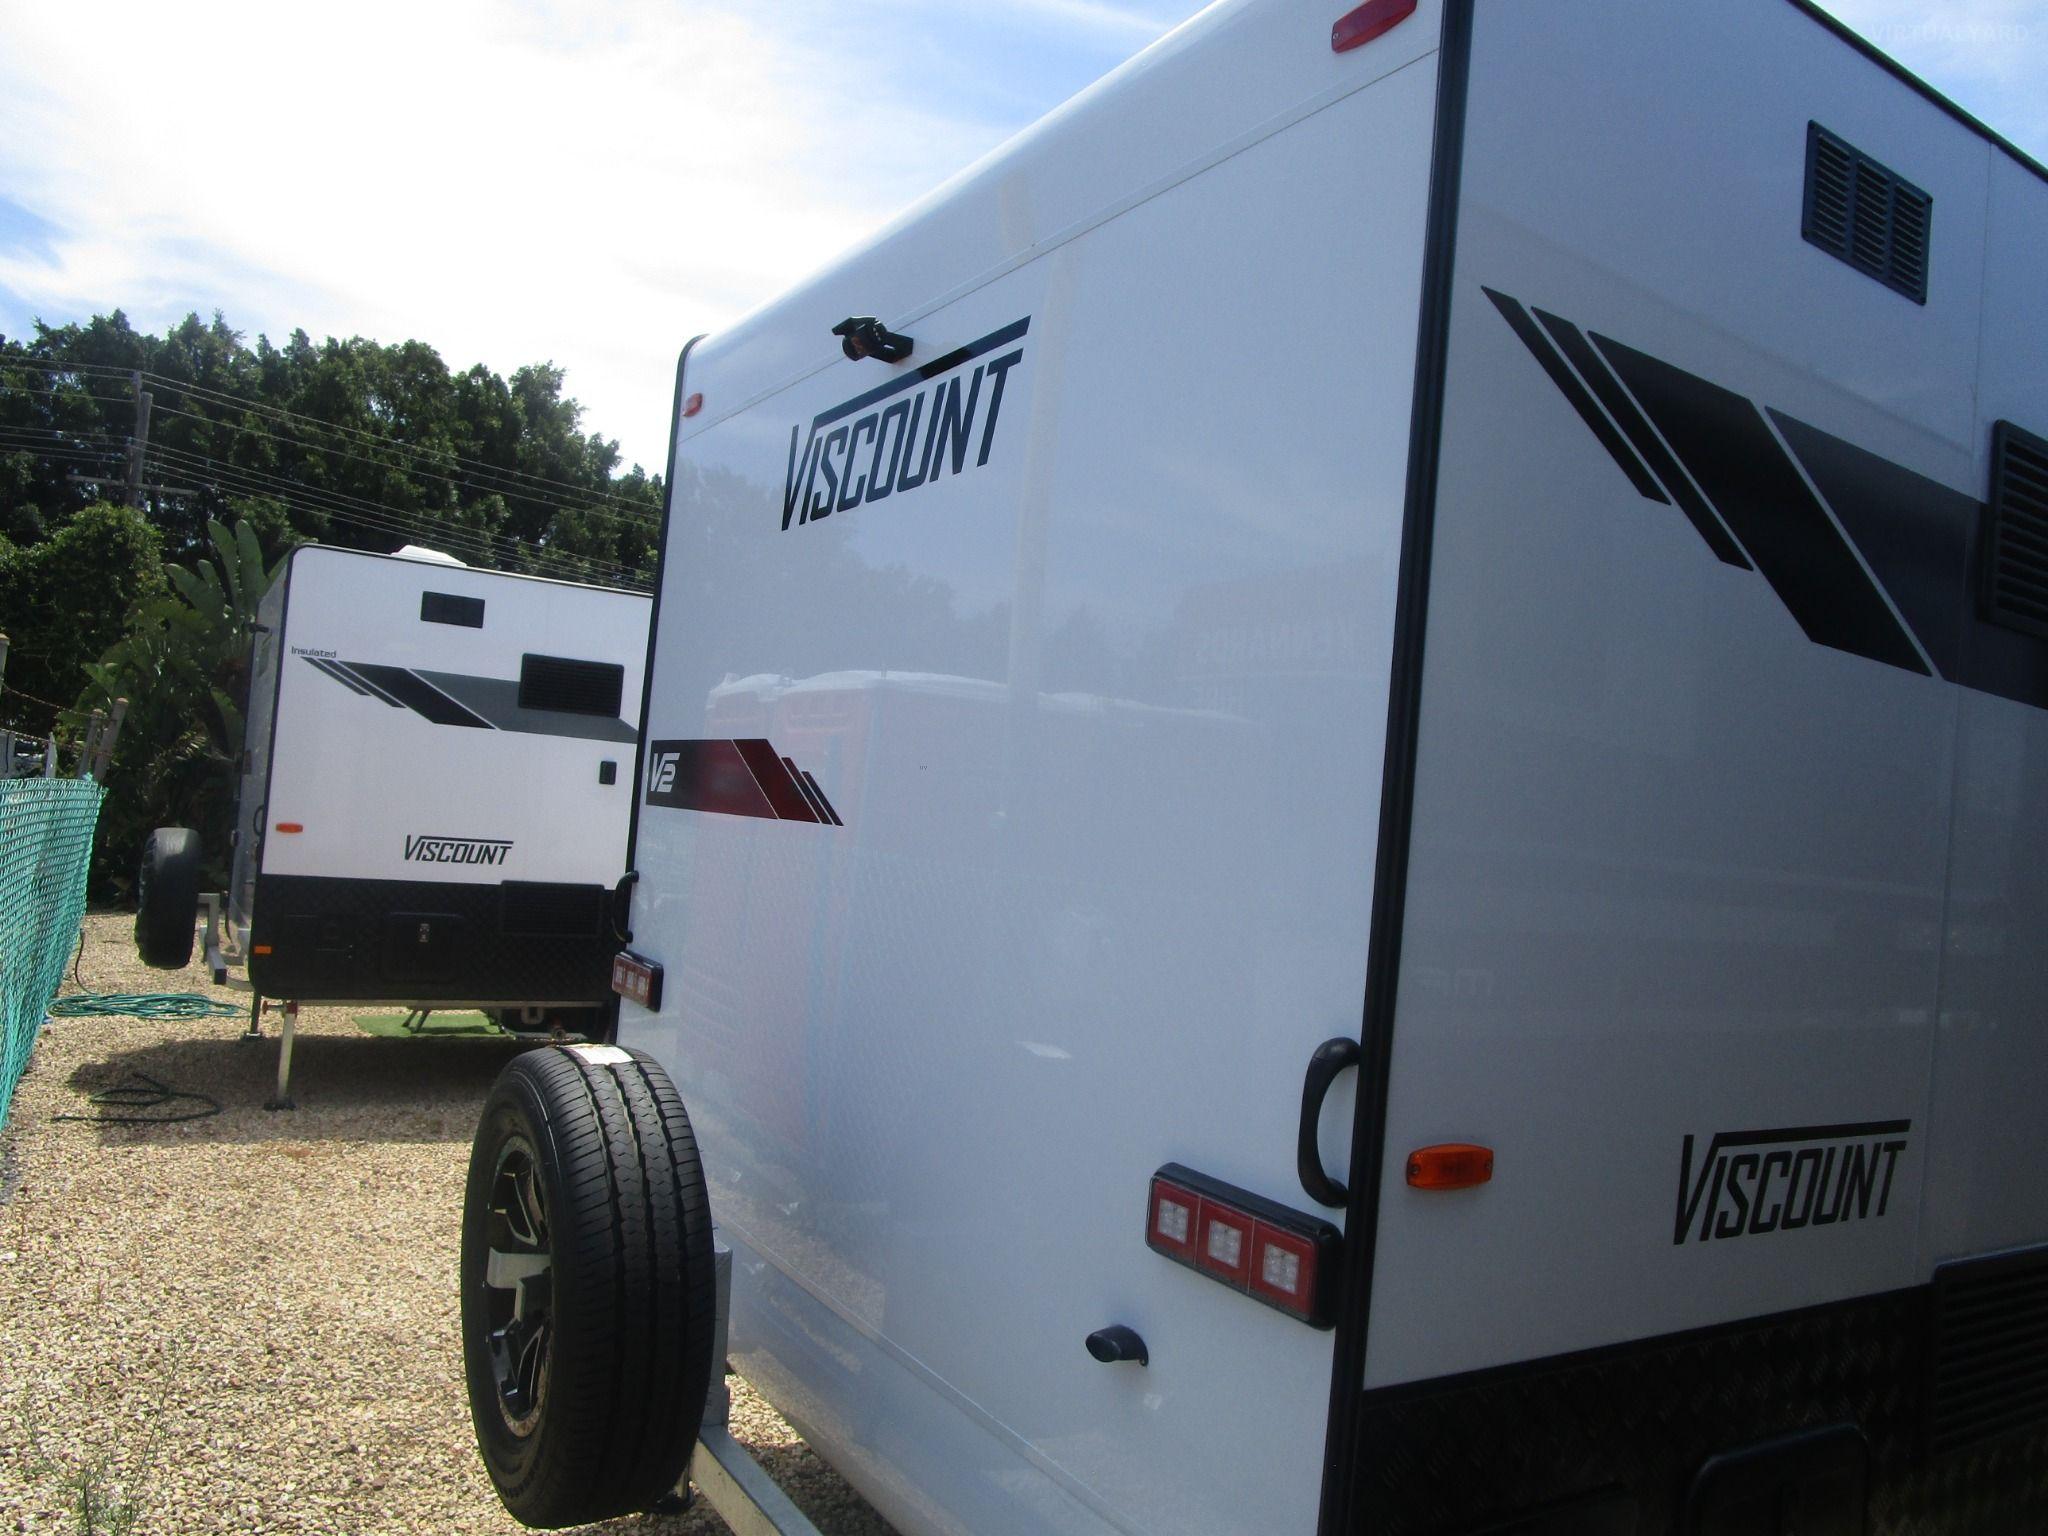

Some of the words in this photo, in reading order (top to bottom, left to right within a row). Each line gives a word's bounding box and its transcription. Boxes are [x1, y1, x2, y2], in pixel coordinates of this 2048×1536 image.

[781, 315, 1031, 531] VISCOUNT
[291, 646, 336, 658] Insulated
[650, 752, 680, 792] V2
[404, 834, 513, 865] VISCOUNT
[1673, 1119, 1911, 1245] VISCOUNT
